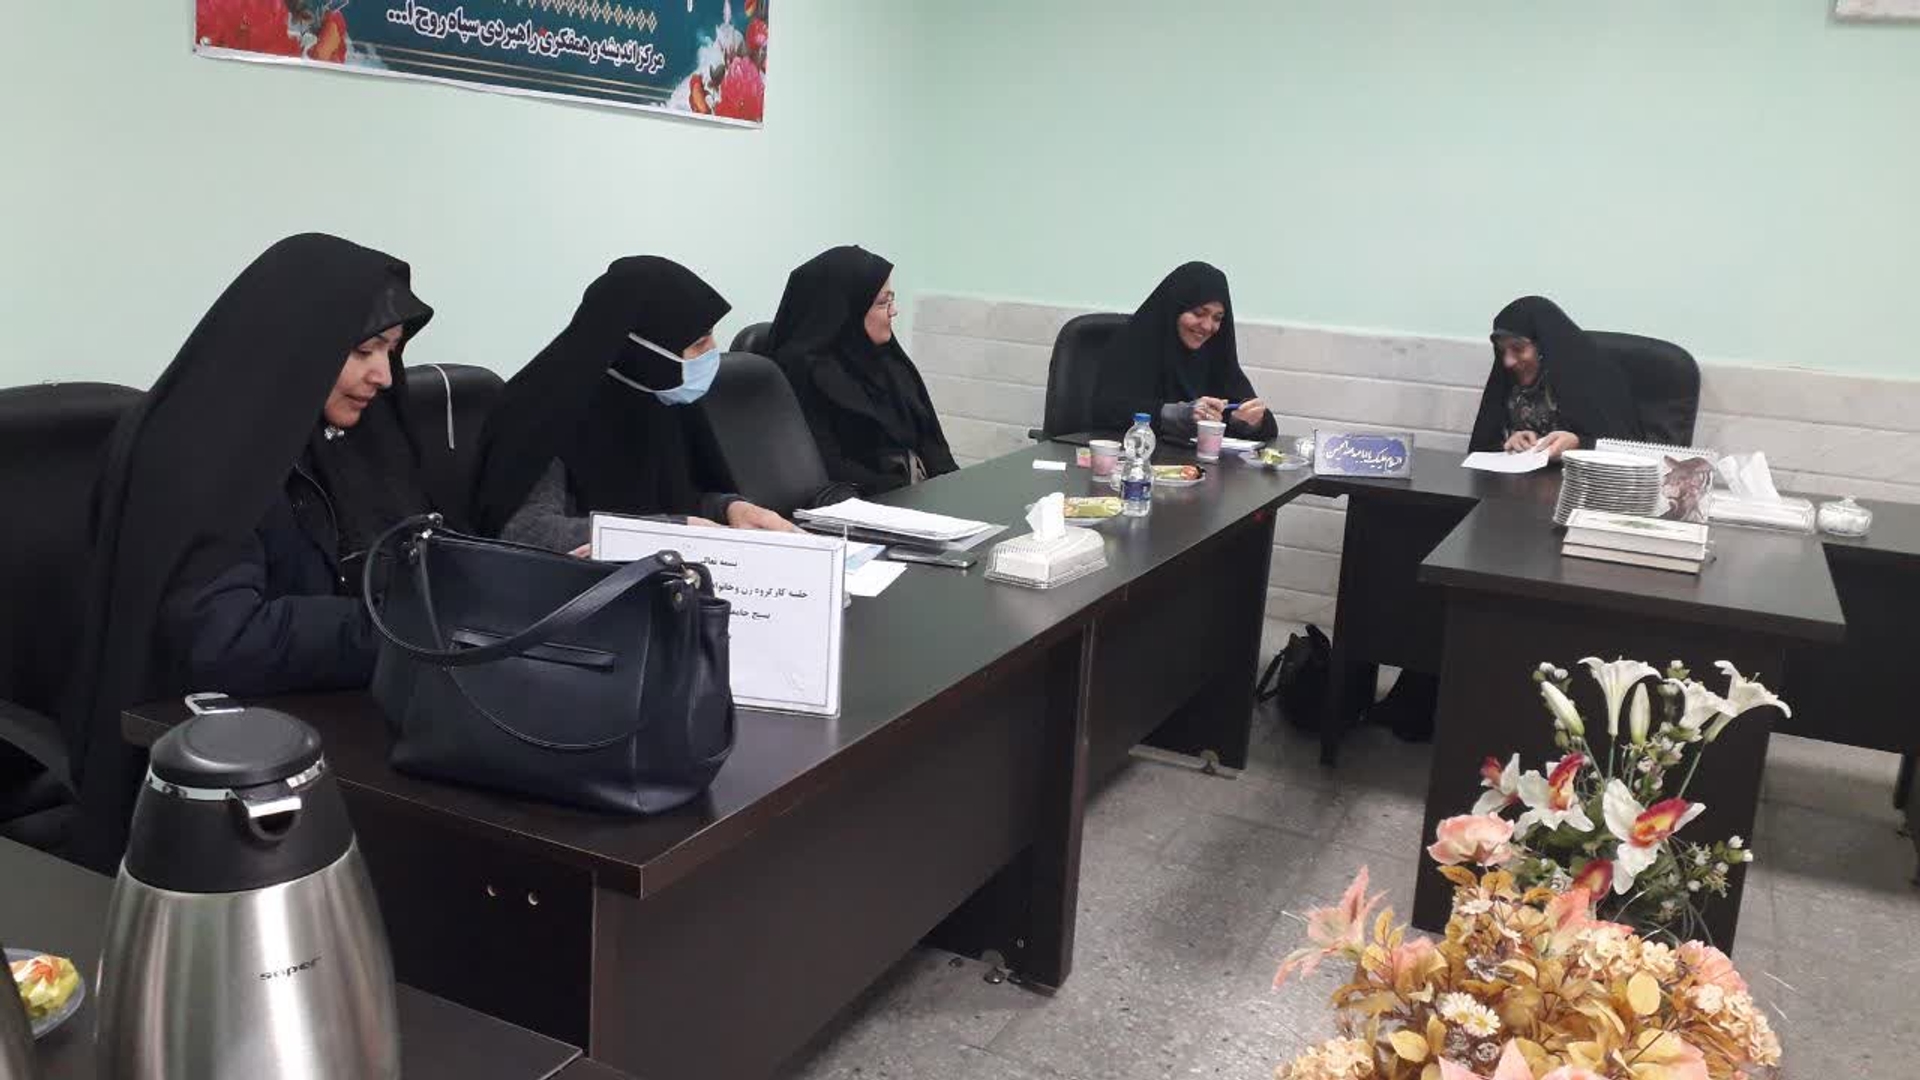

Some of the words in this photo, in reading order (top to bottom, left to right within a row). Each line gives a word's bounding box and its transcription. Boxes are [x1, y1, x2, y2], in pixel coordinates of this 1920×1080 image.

[415, 6, 446, 38] روح
[448, 6, 480, 43] سپاه
[479, 19, 540, 54] راهبردی
[540, 27, 590, 58] همفکری
[589, 41, 601, 64] و
[600, 36, 638, 67] اندیشه
[635, 43, 665, 74] مرکز
[701, 556, 717, 565] تعال
